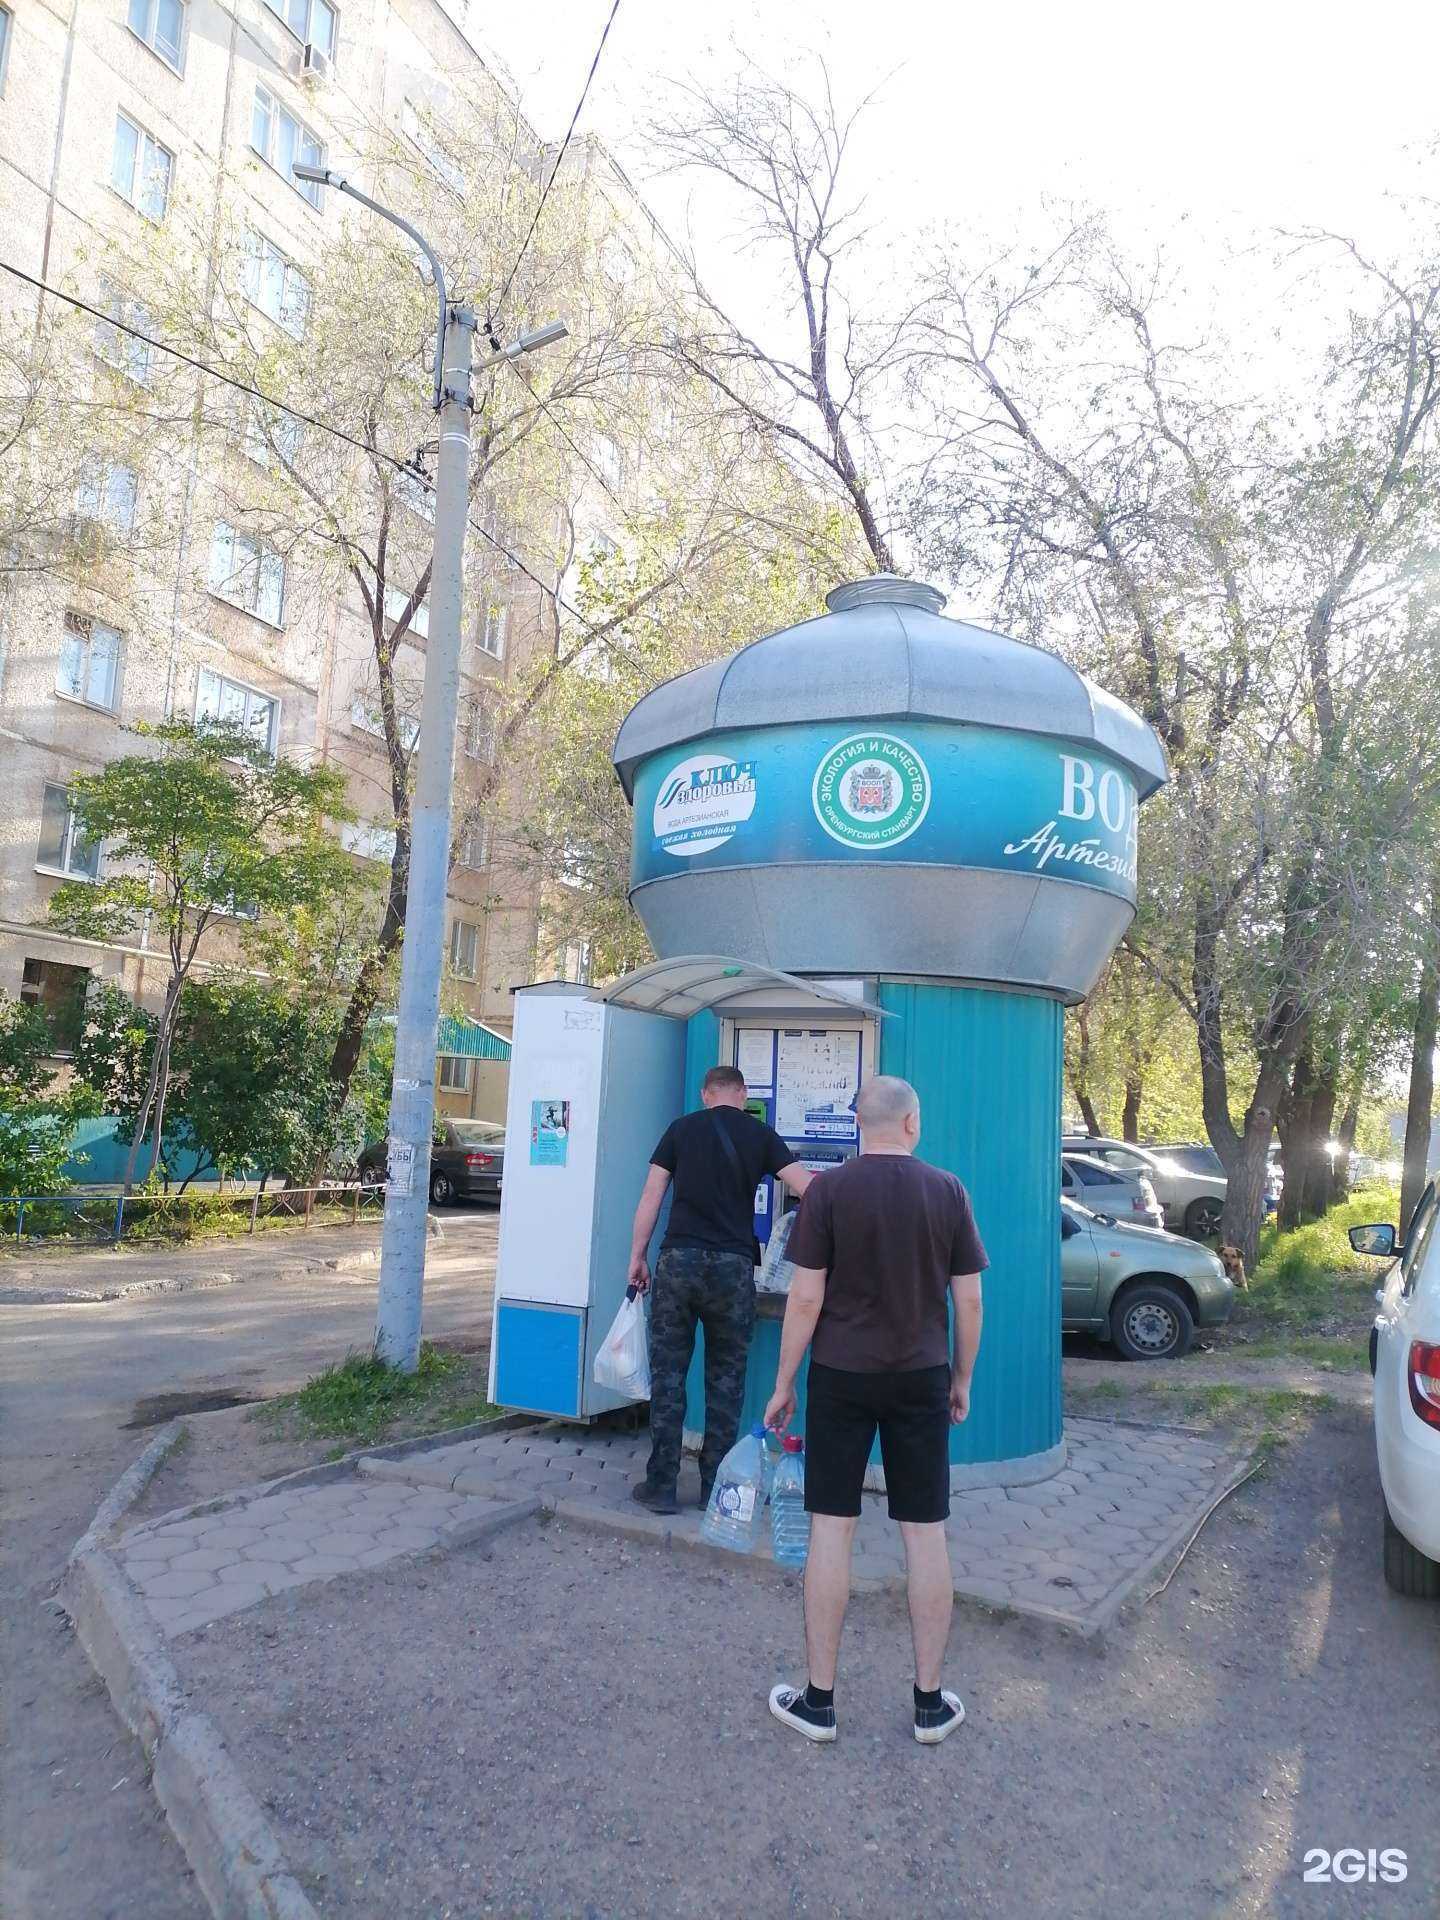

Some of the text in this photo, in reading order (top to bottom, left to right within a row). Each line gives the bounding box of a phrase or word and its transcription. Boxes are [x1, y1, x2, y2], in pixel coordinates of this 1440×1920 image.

[821, 741, 923, 802] ЭКОЛОГИЯ И КАЧЕСТВО
[825, 805, 917, 840] ОРЕНБУРГСКИЙ СТАНДАРТ
